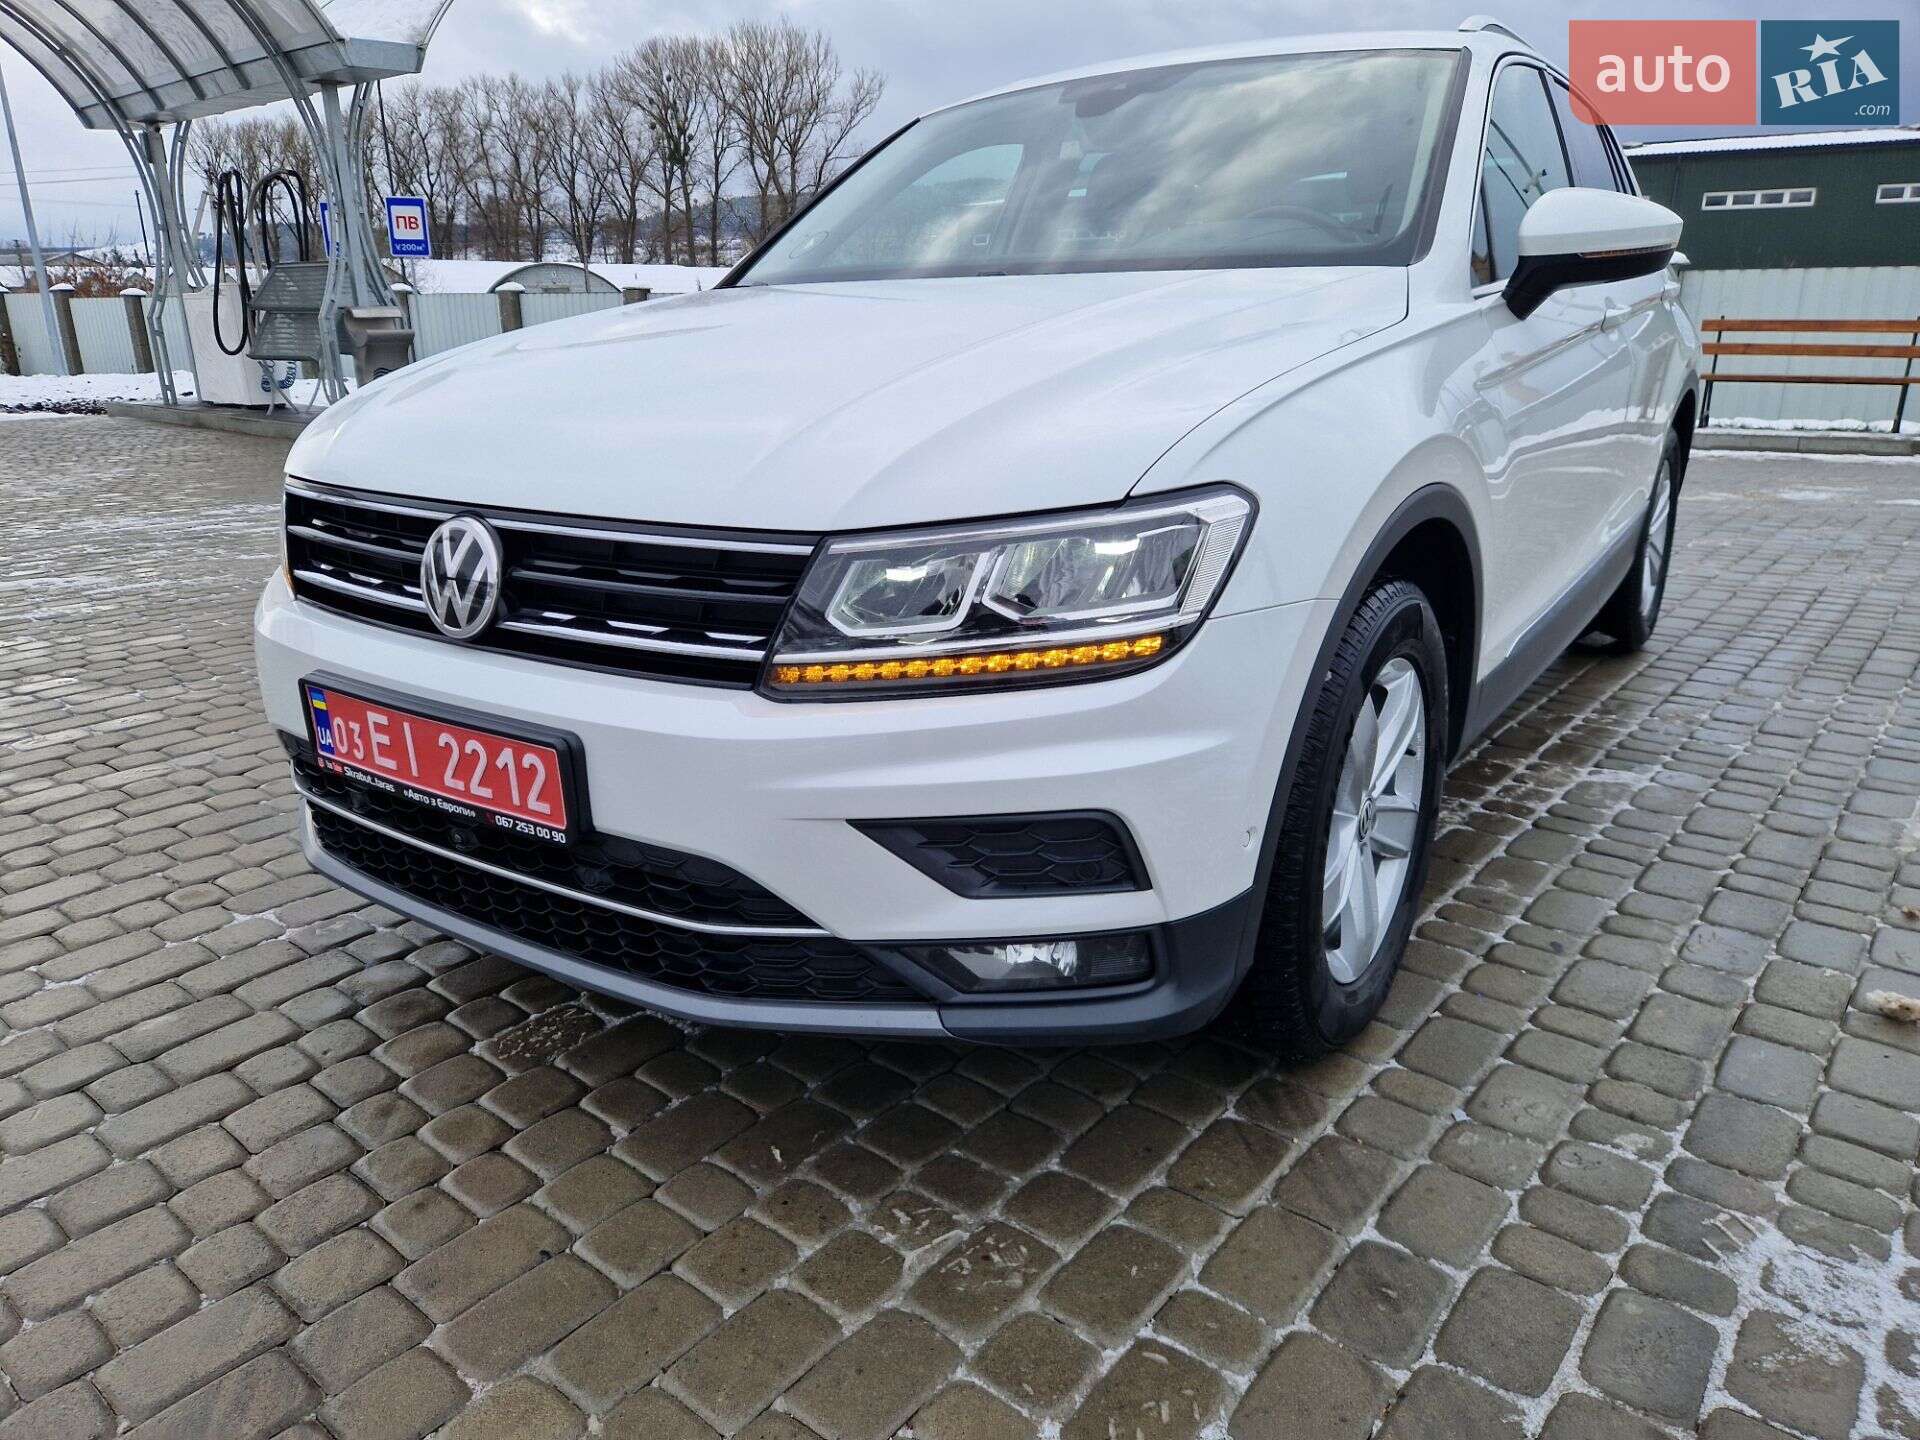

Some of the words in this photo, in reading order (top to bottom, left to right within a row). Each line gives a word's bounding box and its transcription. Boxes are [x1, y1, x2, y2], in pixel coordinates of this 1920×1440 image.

[395, 215, 420, 230] ПВ
[318, 728, 333, 748] UA
[438, 732, 551, 815] 2212
[495, 814, 514, 829] 067
[515, 820, 535, 836] 253
[536, 826, 550, 840] 00
[551, 831, 567, 844] 90
